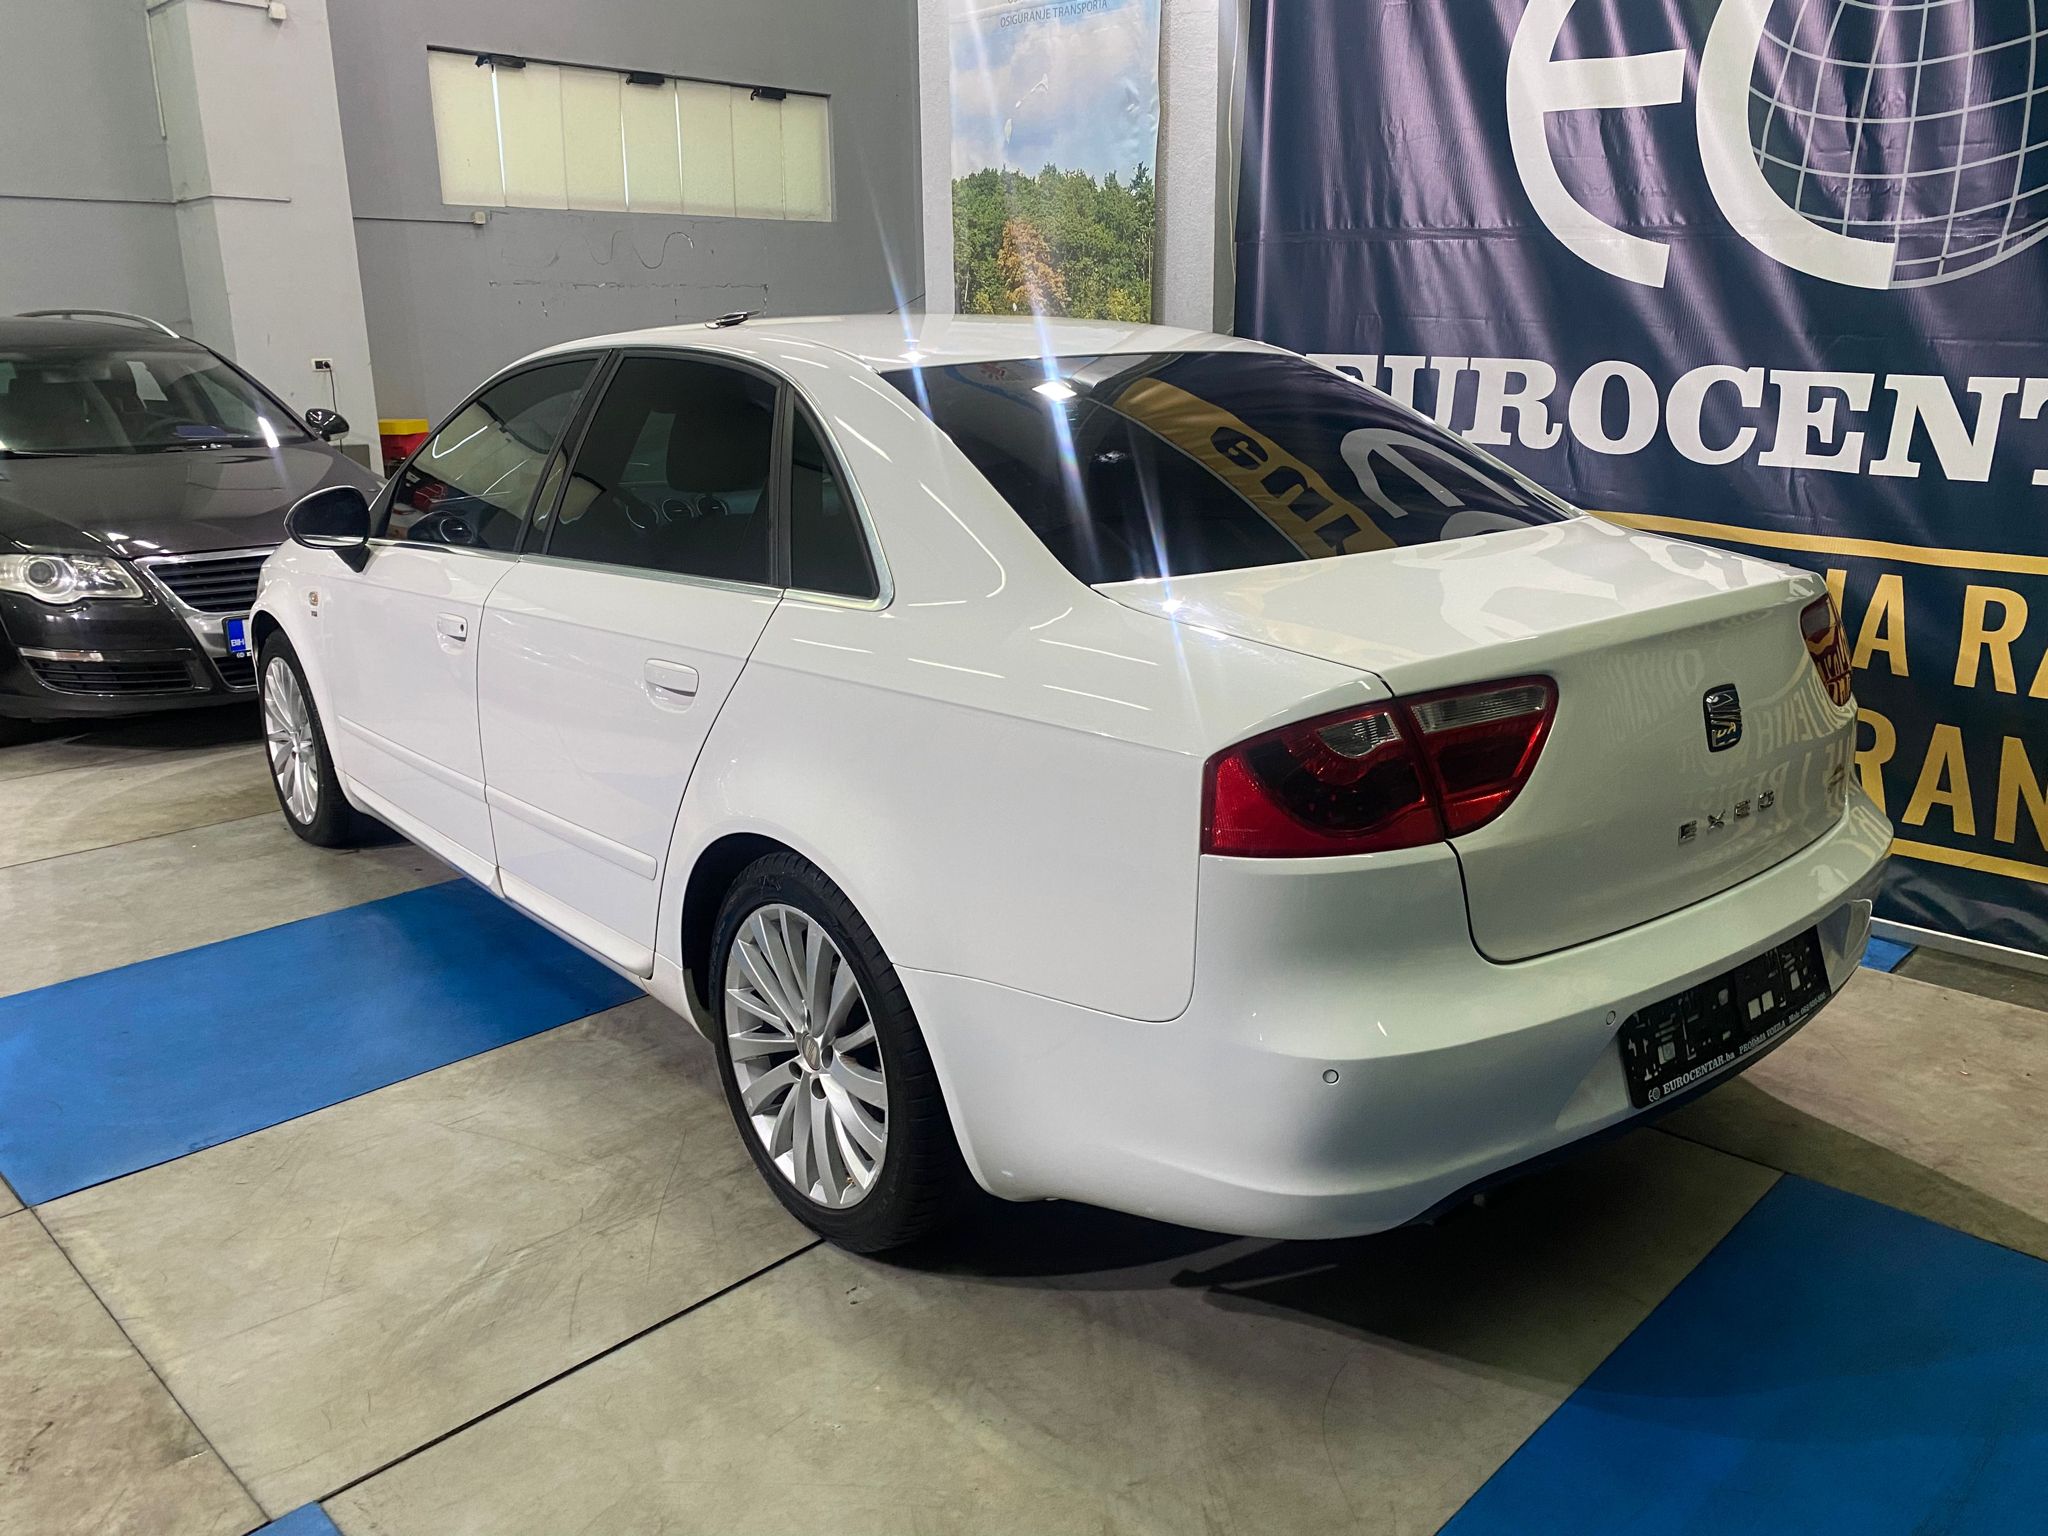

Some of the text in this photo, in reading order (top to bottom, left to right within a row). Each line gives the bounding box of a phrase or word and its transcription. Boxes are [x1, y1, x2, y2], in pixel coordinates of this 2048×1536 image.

[1000, 0, 1107, 28] OSIGURANJE TRANSPORTA
[1953, 584, 2048, 700] R
[1678, 789, 1775, 846] EXEO
[1662, 1051, 1736, 1096] EUROCENTAR.ba
